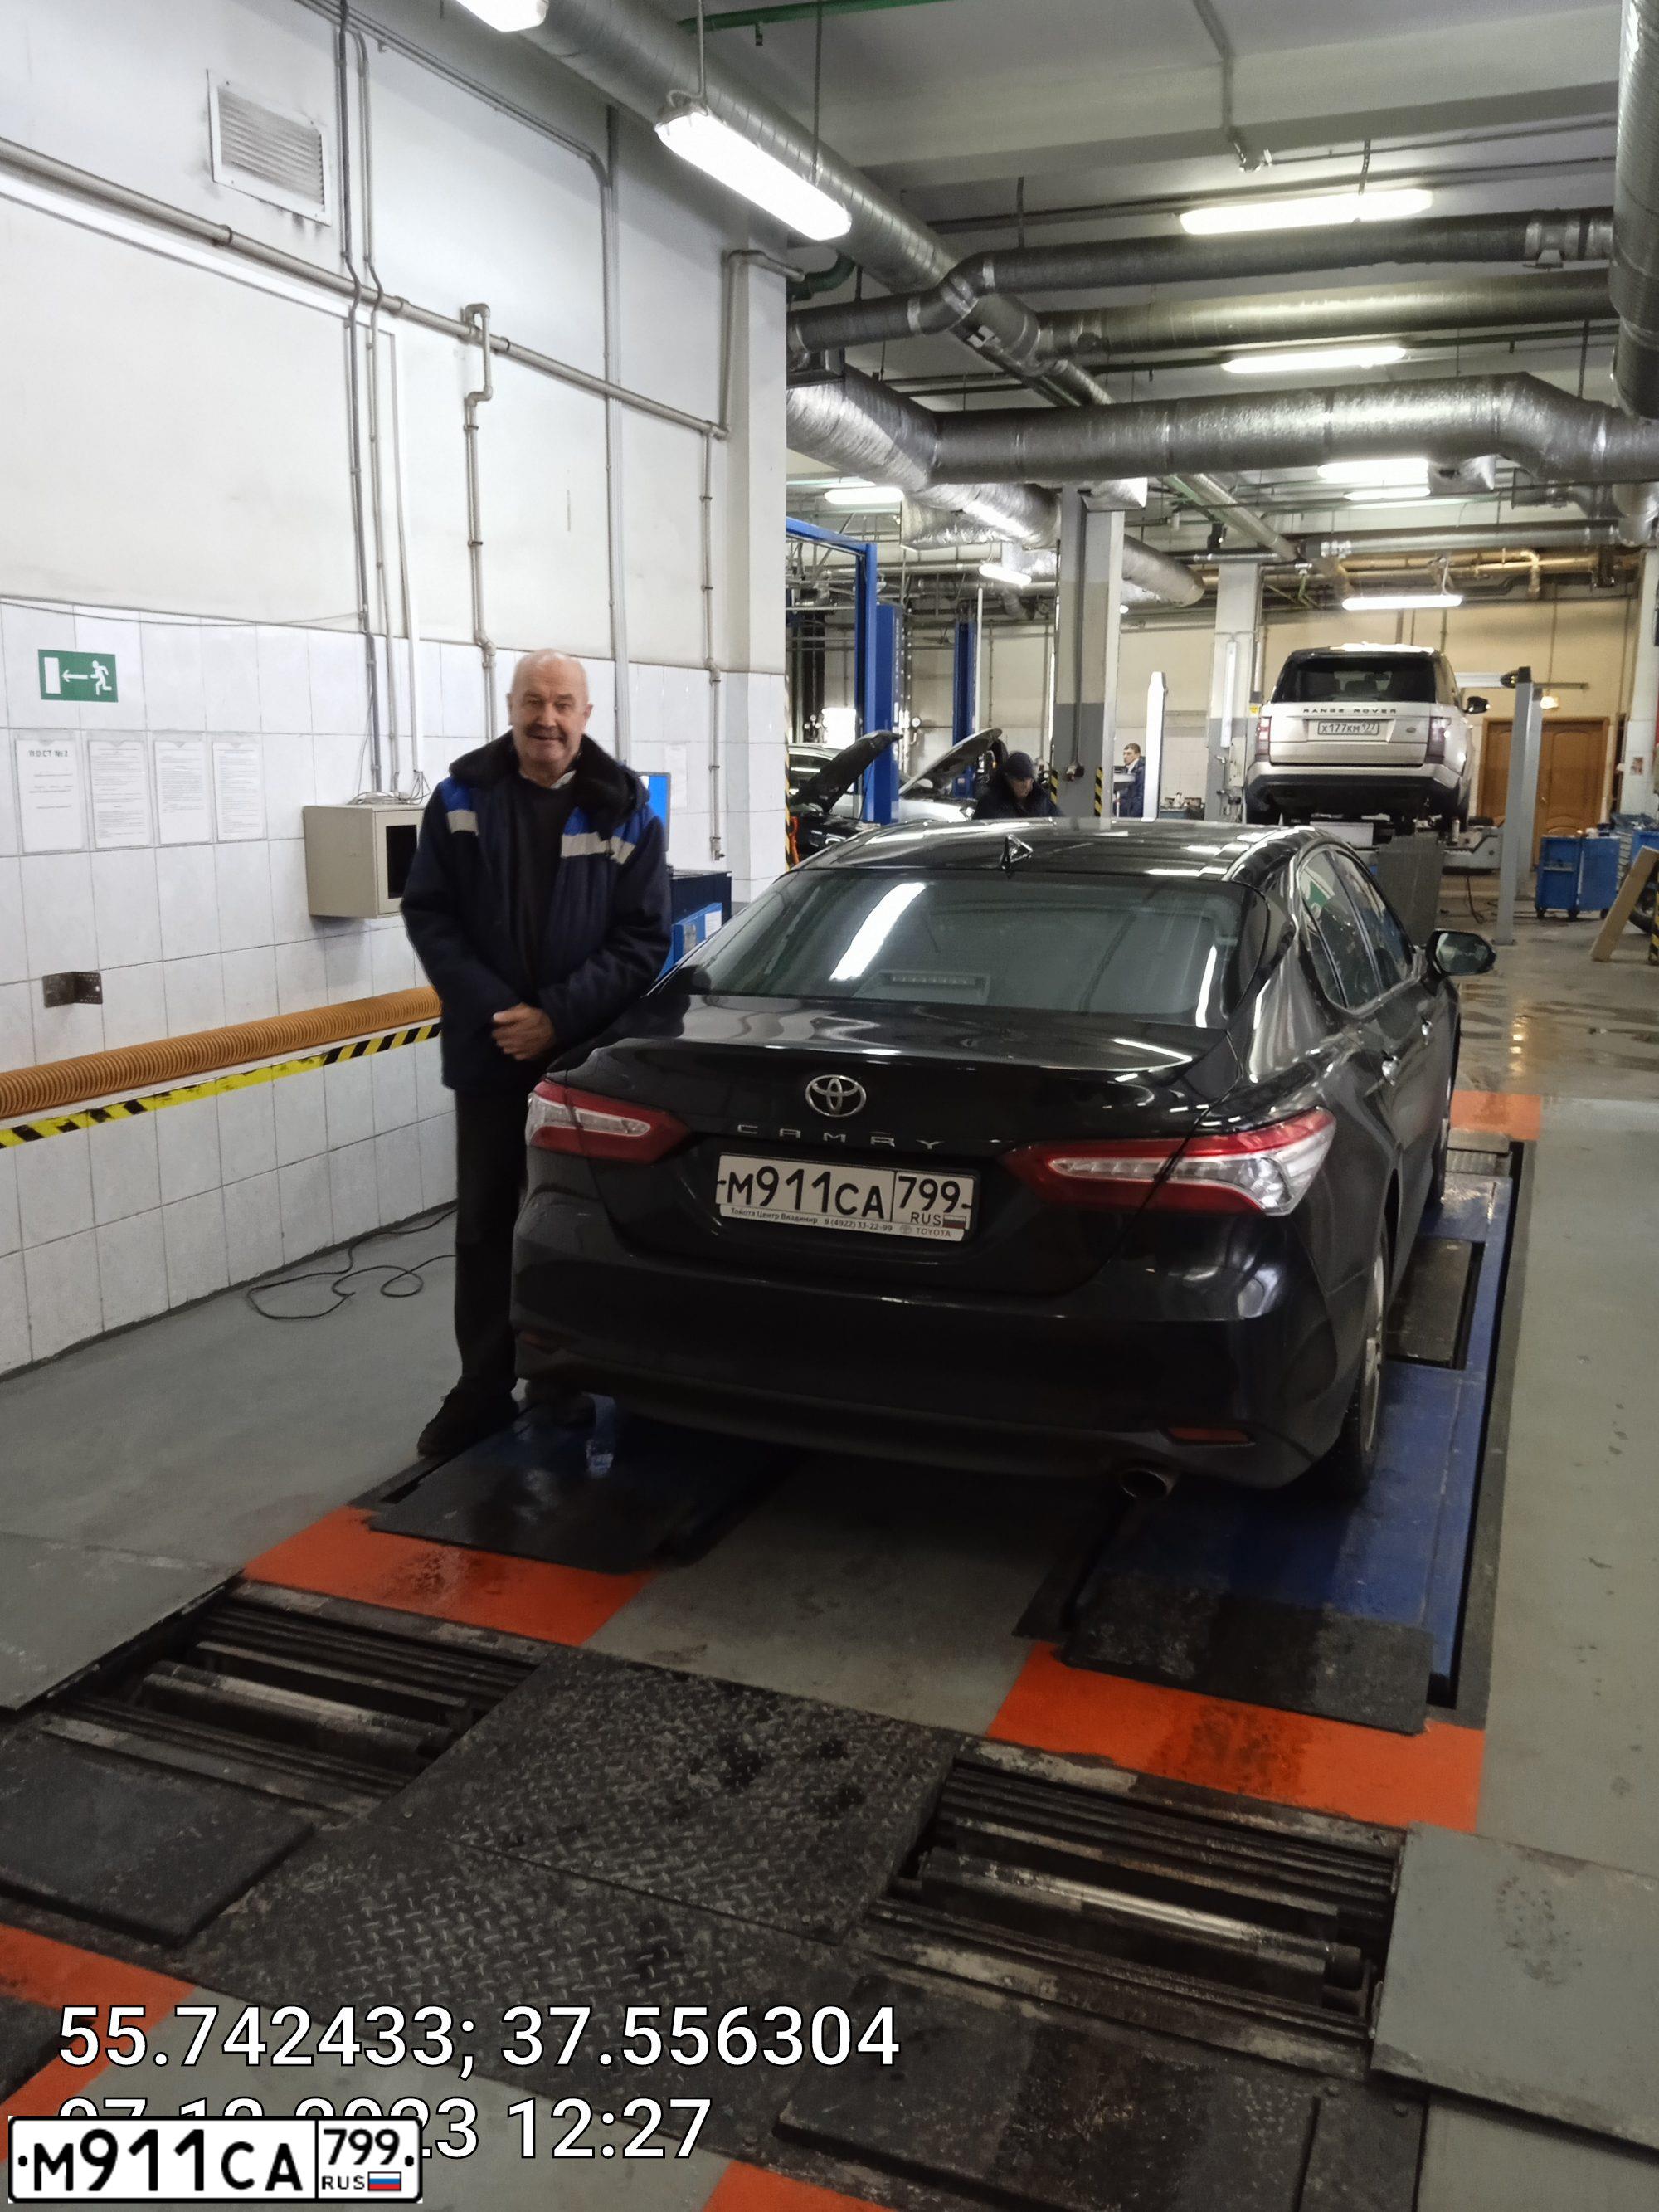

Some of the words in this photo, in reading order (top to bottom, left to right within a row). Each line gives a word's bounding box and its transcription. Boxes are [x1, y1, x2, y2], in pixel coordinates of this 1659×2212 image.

[737, 1124, 944, 1150] CAMRY
[898, 1176, 961, 1213] 799
[731, 1207, 756, 1216] Тойота
[757, 1210, 780, 1220] Центр
[781, 1213, 818, 1224] Владимир
[830, 1220, 856, 1229] (4922)
[858, 1222, 893, 1232] 33-22-99
[911, 1212, 941, 1225] RUS
[917, 1227, 951, 1237] TOYOTA
